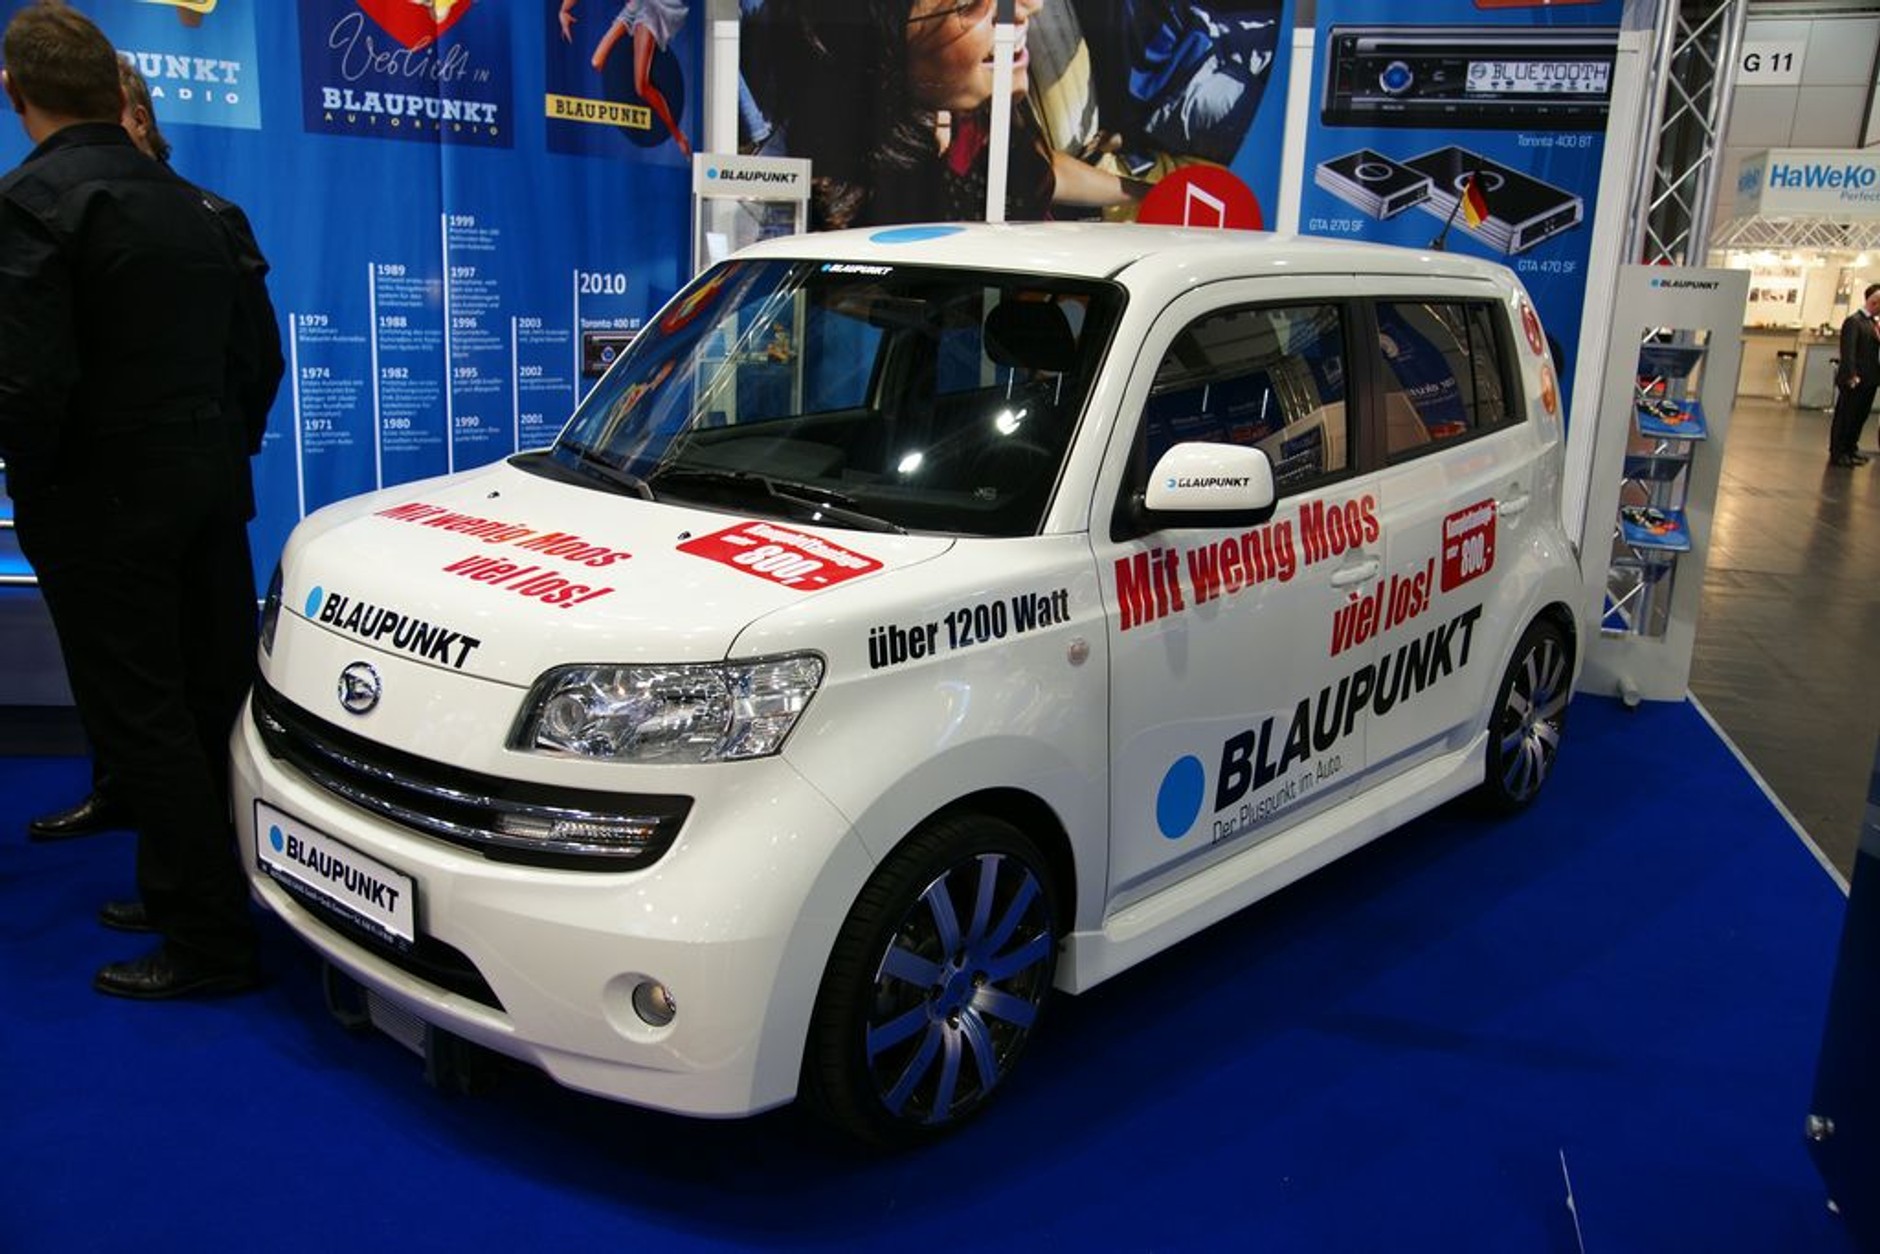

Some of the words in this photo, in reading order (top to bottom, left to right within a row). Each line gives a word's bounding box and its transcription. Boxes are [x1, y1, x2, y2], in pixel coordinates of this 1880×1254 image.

[1744, 53, 1761, 72] G
[1770, 53, 1793, 72] 11
[1491, 64, 1608, 81] BLUETOOTH
[322, 87, 498, 124] BLAUPUNKT
[556, 100, 648, 125] BLAUPUNKT
[1555, 135, 1577, 148] 400
[1579, 136, 1593, 148] BT
[720, 169, 799, 184] BLAUPUNKT
[1769, 164, 1876, 189] HaWeKo
[449, 215, 475, 227] 1999
[1309, 218, 1329, 232] GTA
[1330, 219, 1351, 232] 270
[1352, 220, 1364, 232] SF
[377, 264, 406, 276] 1989
[450, 266, 476, 278] 1997
[828, 264, 893, 275] BLAUPUNKT
[1518, 259, 1539, 272] GTA
[1540, 260, 1562, 273] 470
[1563, 261, 1576, 273] SF
[580, 273, 627, 295] 2010
[1661, 280, 1719, 289] BLAUPUNKT
[300, 314, 328, 326] 1979
[379, 316, 407, 328] 1988
[452, 317, 477, 328] 1996
[613, 318, 629, 328] 400
[302, 368, 330, 379] 1974
[381, 368, 409, 379] 1982
[453, 367, 478, 378] 1995
[304, 419, 332, 430] 1971
[383, 418, 411, 429] 1980
[455, 417, 480, 428] 1990
[1178, 478, 1250, 488] BLAUPUNKT
[373, 502, 448, 522] Mit
[420, 512, 538, 544] wenig
[512, 531, 632, 567] Moos
[1114, 551, 1184, 631] Mit
[1187, 520, 1297, 605] wenig
[1299, 493, 1380, 567] Moos
[442, 554, 541, 585] viel
[505, 571, 615, 609] los!
[1330, 580, 1386, 658] viel
[1384, 557, 1436, 632] los!
[320, 592, 481, 670] BLAUPUNKT
[868, 624, 939, 670] über
[943, 600, 1008, 650] 1200
[1011, 588, 1071, 634] Watt
[1214, 602, 1484, 814] BLAUPUNKT
[1211, 818, 1237, 845] Der
[1239, 780, 1296, 824] Pluspunkt
[1299, 772, 1314, 793] im
[286, 834, 400, 914] BLAUPUNKT
